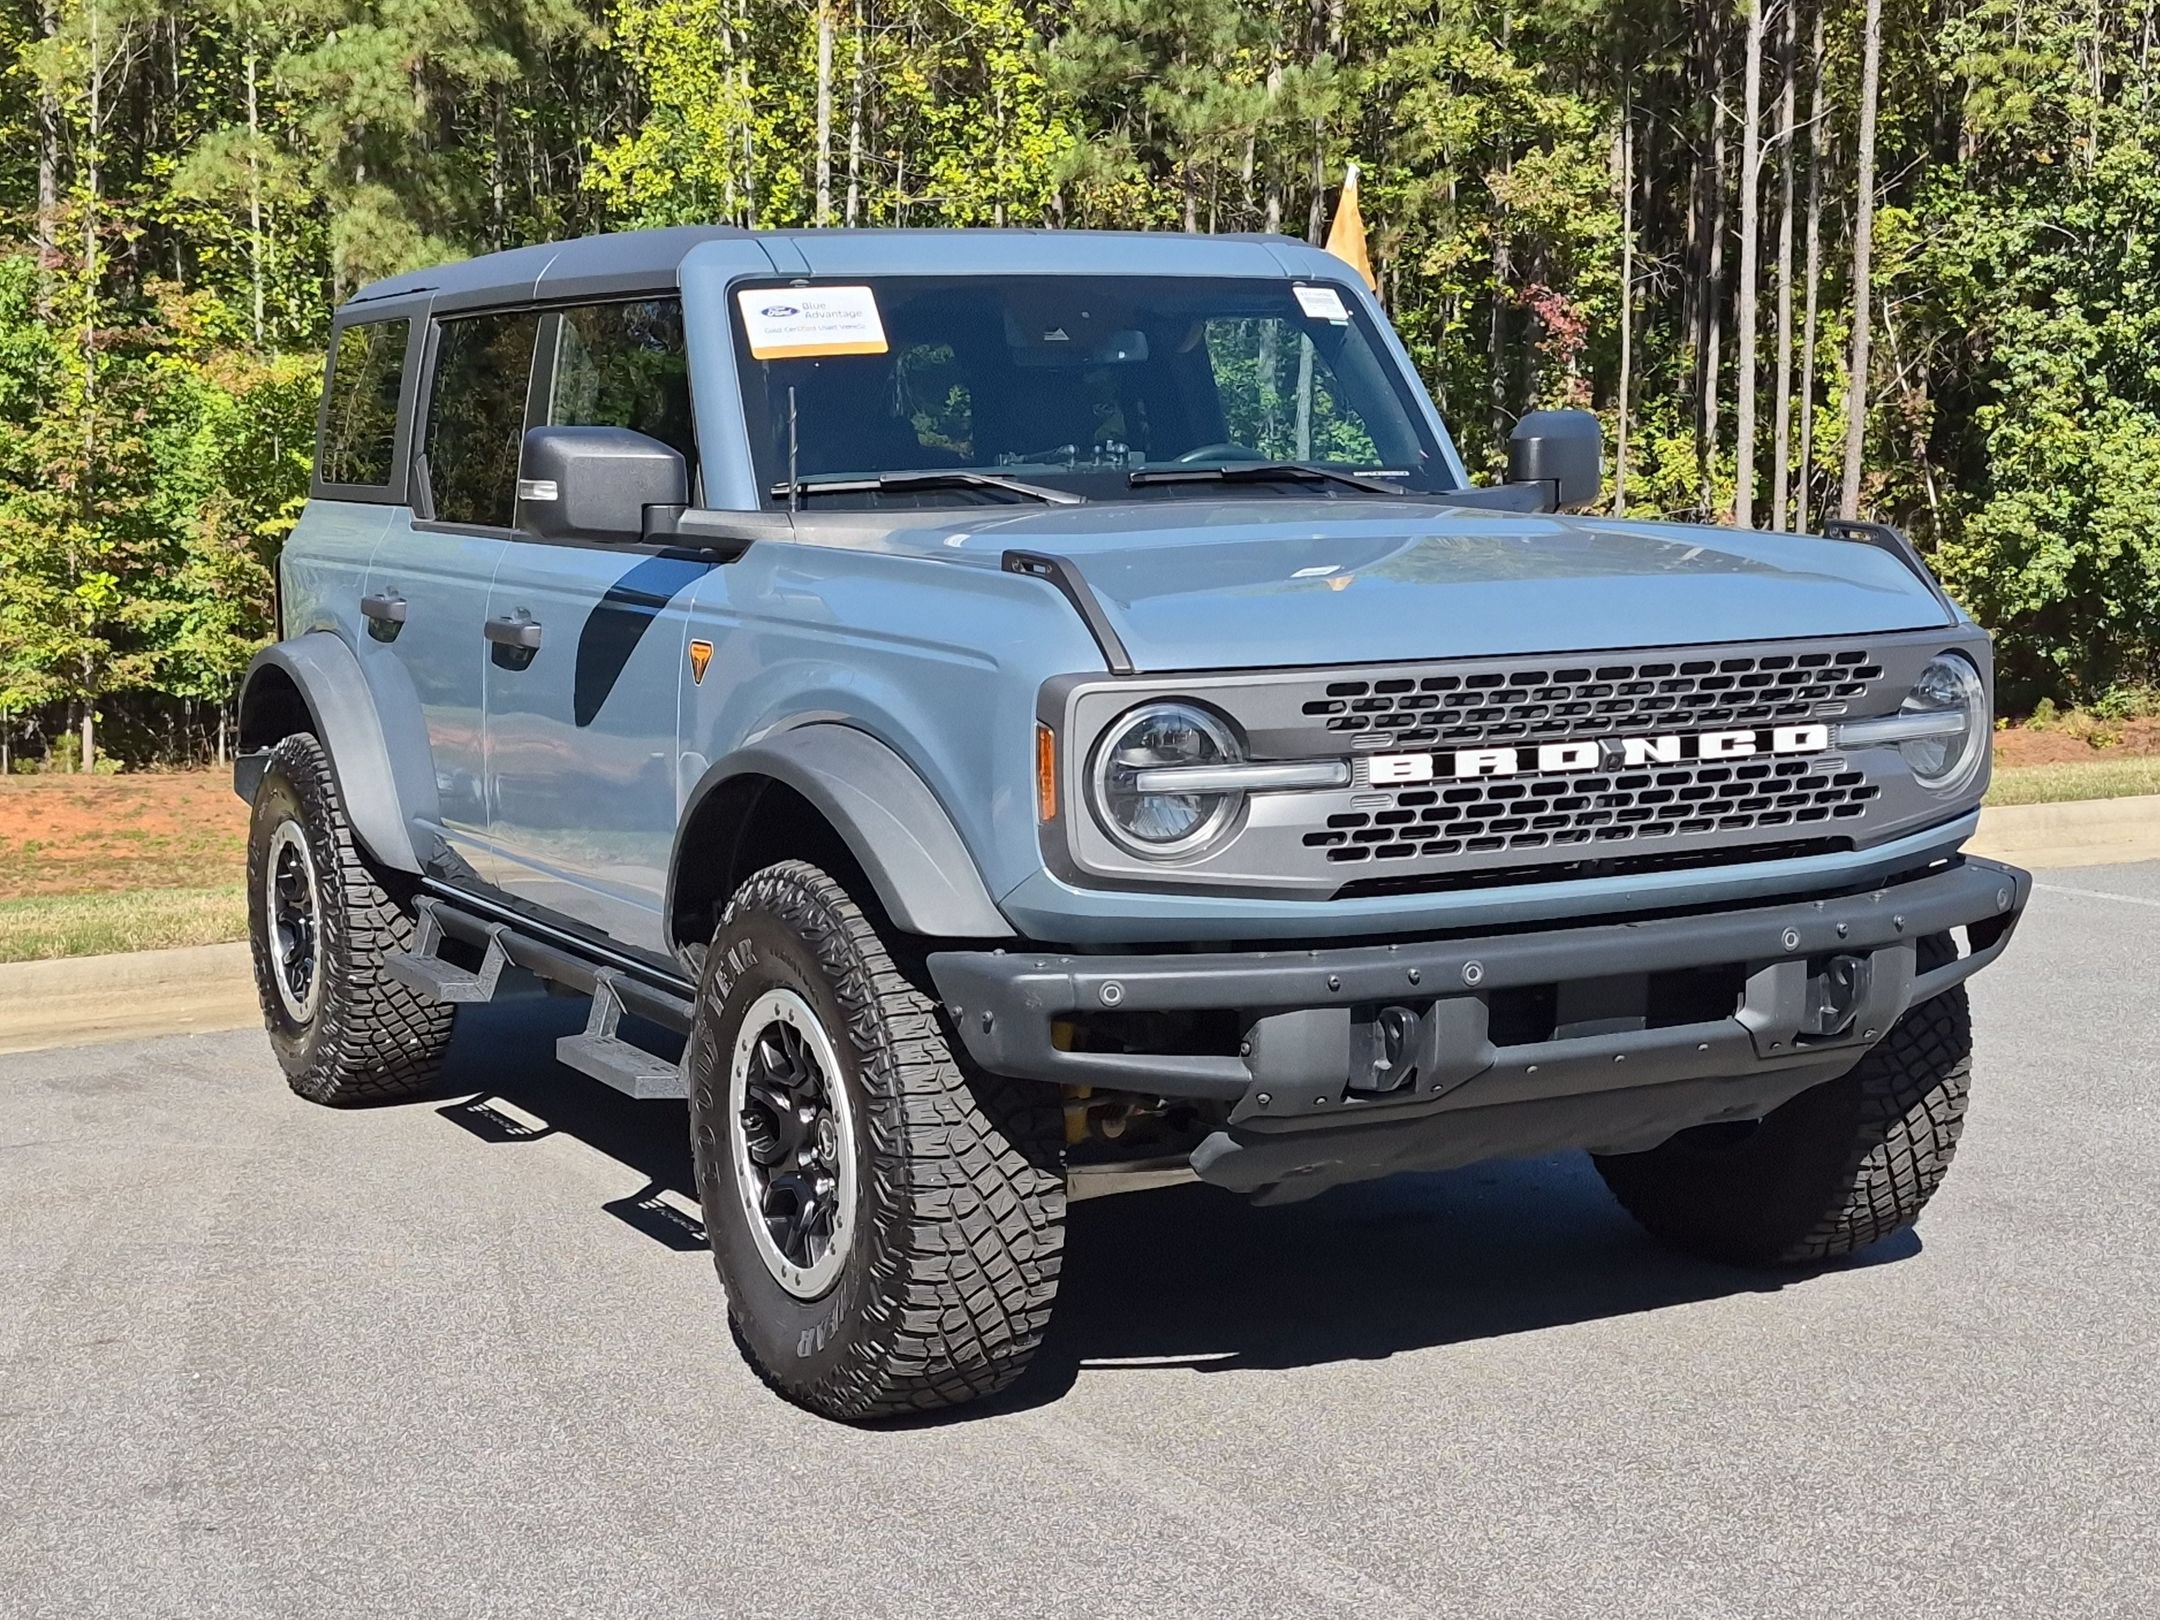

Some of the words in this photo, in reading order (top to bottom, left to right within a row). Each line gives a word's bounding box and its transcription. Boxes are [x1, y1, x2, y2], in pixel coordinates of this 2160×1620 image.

[801, 302, 827, 311] Blue
[805, 310, 863, 319] Advantage
[1368, 723, 1829, 784] BRONCO
